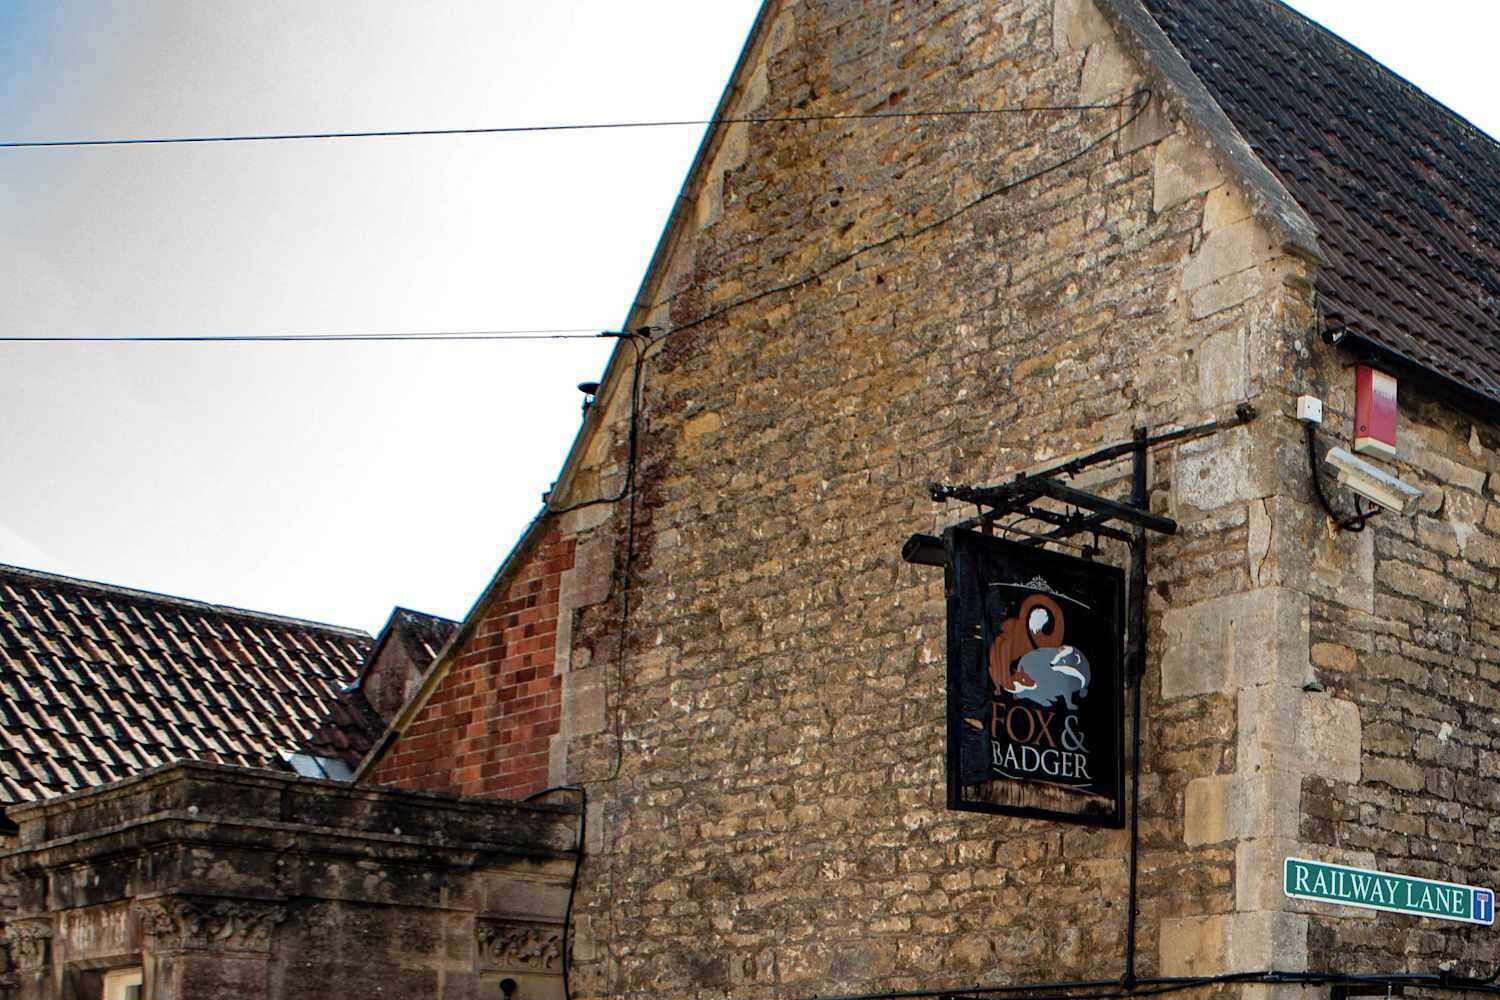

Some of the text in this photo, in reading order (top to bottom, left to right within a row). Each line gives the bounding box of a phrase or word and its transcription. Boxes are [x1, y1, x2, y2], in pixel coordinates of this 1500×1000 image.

[991, 701, 1091, 754] FOX &
[990, 739, 1093, 780] BADGER
[1294, 864, 1464, 914] RAILWAY LANE
